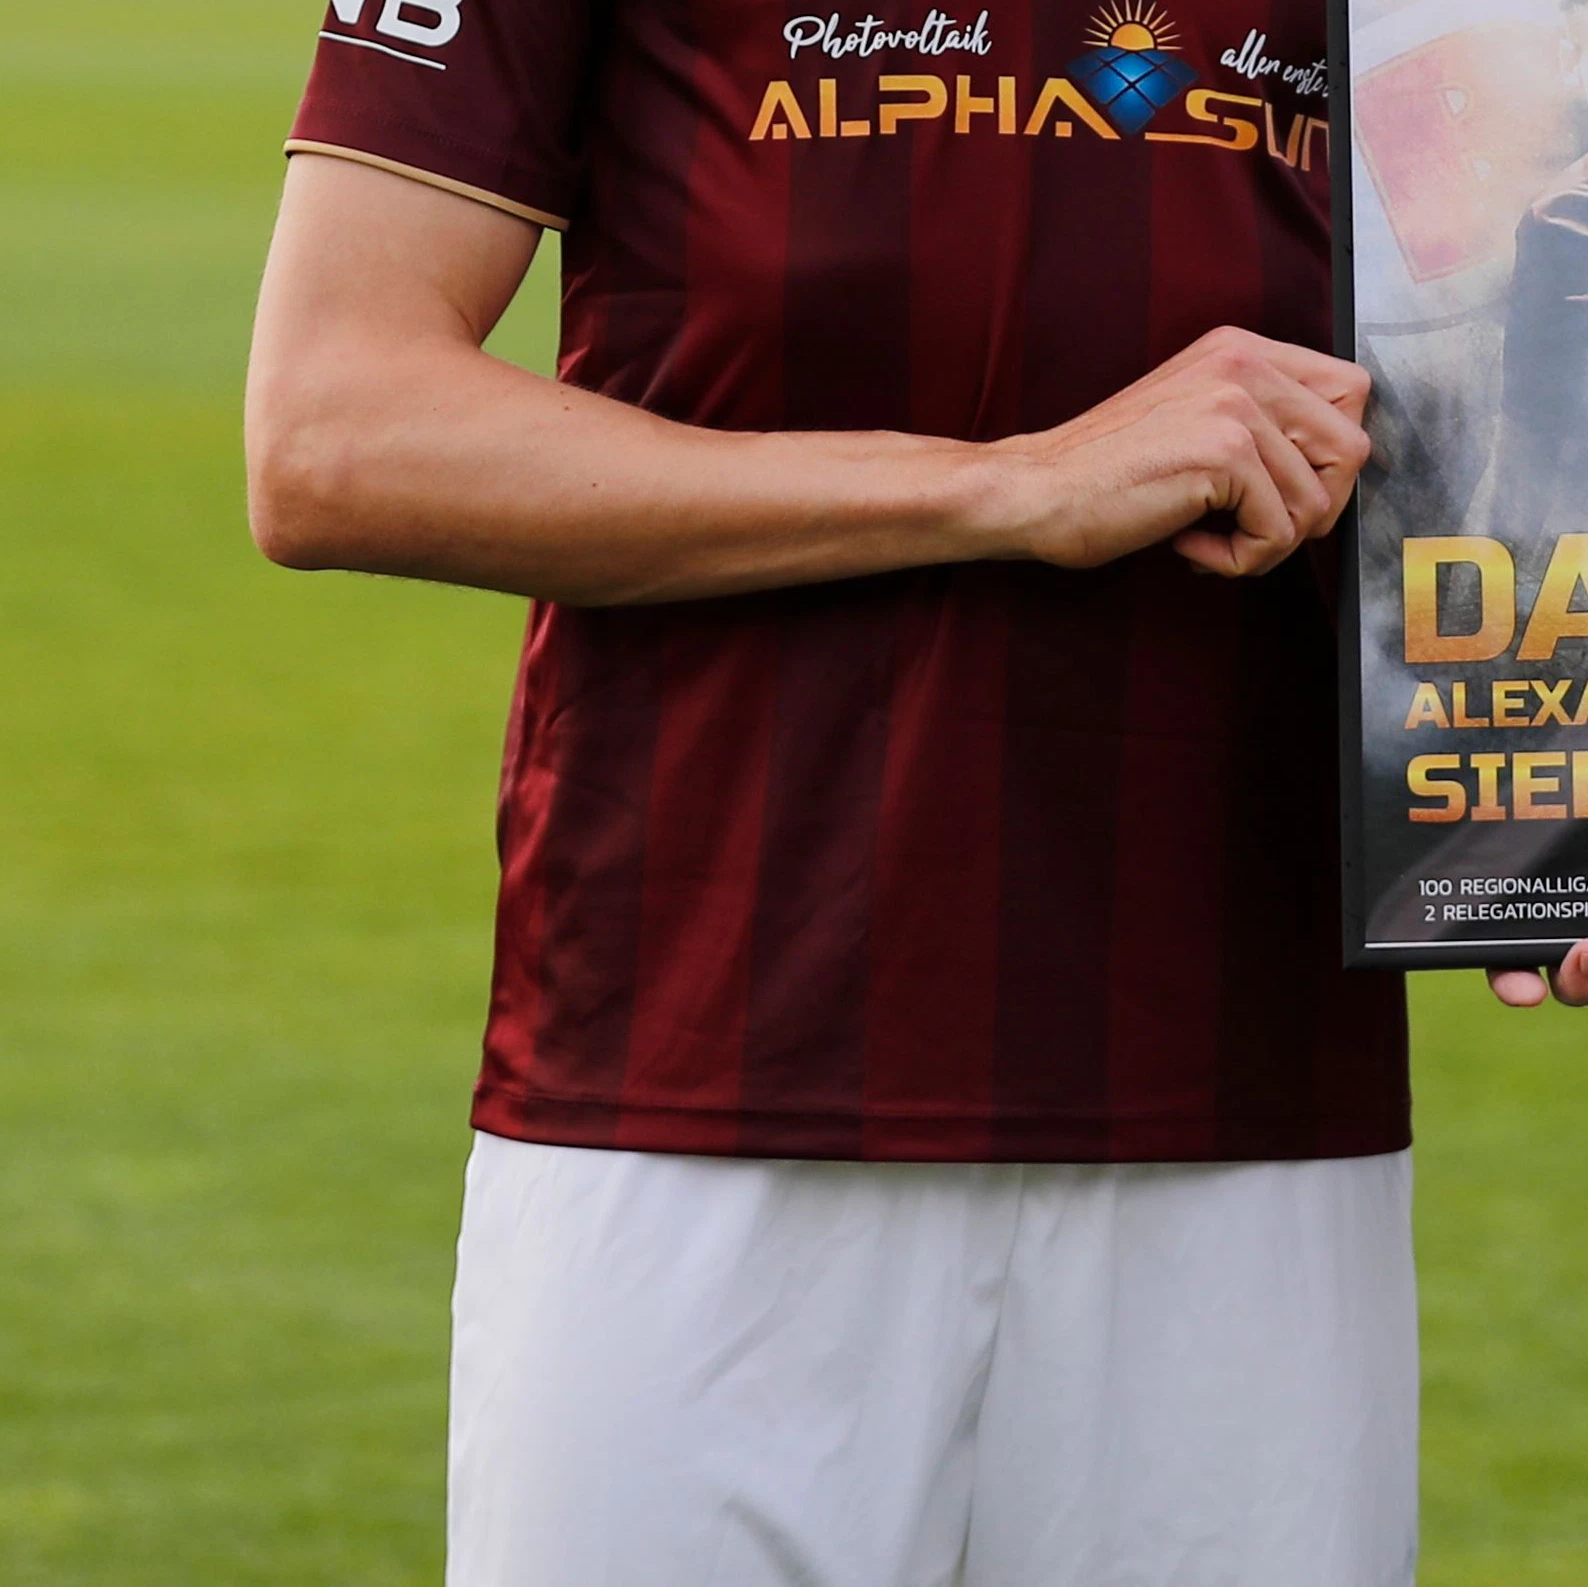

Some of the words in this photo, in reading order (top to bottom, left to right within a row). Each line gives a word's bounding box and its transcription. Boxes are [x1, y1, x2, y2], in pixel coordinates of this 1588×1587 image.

[783, 9, 992, 60] Photovoltaik
[1220, 28, 1280, 80] aller
[748, 74, 1121, 140] ALPHA
[1419, 879, 1452, 896] 100
[1425, 905, 1436, 922] 2
